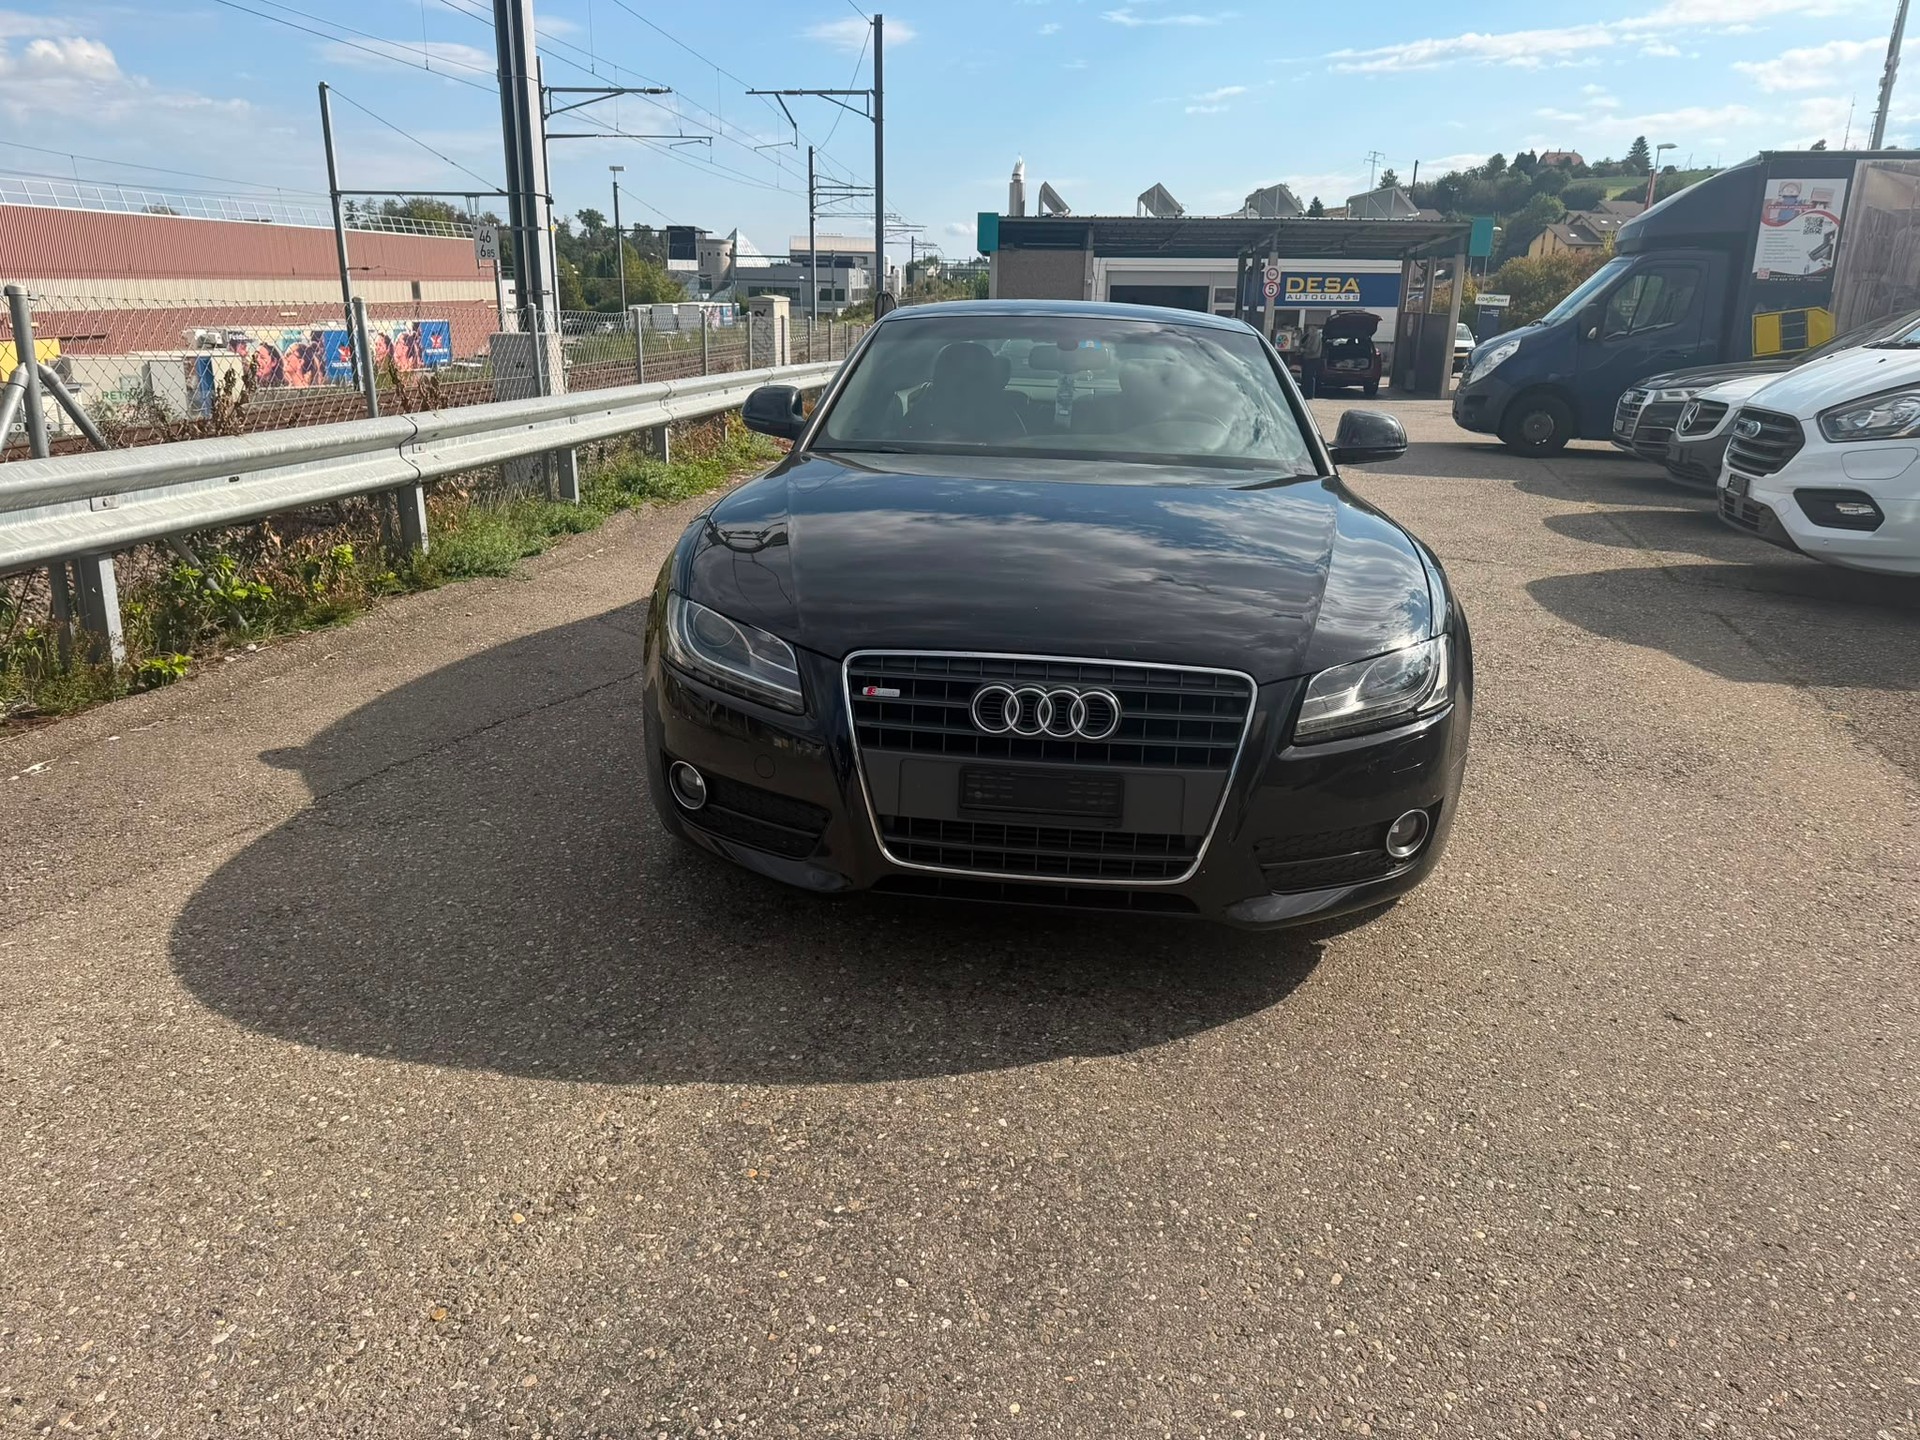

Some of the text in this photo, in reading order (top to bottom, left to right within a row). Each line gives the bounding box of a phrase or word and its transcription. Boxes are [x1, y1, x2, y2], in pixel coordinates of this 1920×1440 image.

[479, 229, 492, 244] 46
[1268, 284, 1275, 294] 5
[1286, 277, 1360, 293] DESA
